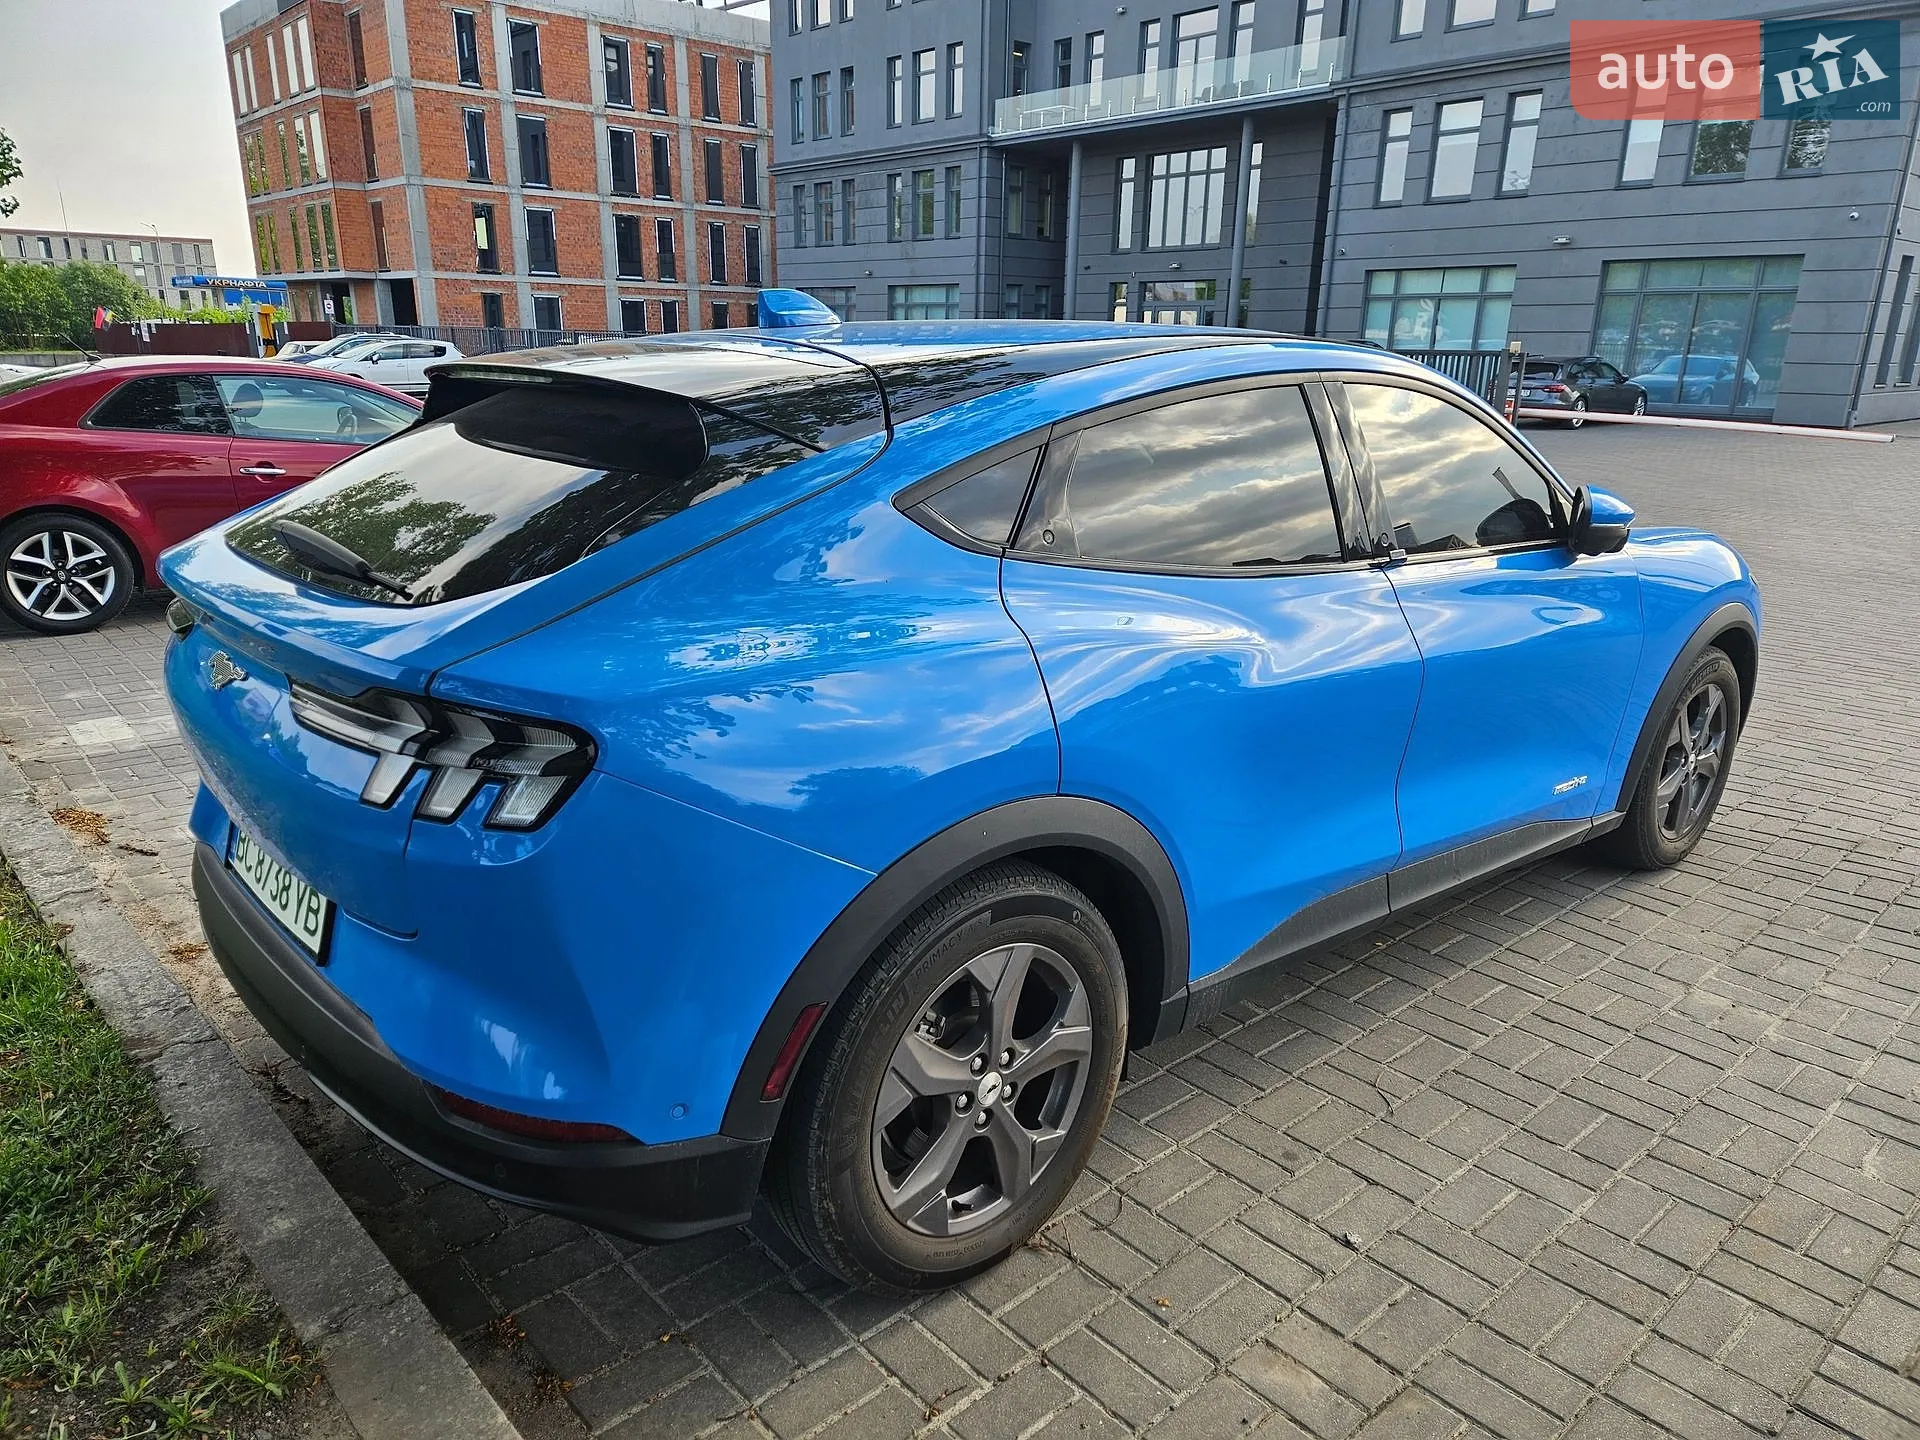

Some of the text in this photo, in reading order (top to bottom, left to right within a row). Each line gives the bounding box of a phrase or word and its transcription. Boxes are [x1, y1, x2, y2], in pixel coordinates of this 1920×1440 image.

[206, 278, 267, 288] УКРНАФТА
[294, 879, 321, 937] YB
[915, 929, 965, 980] PRIMACY
